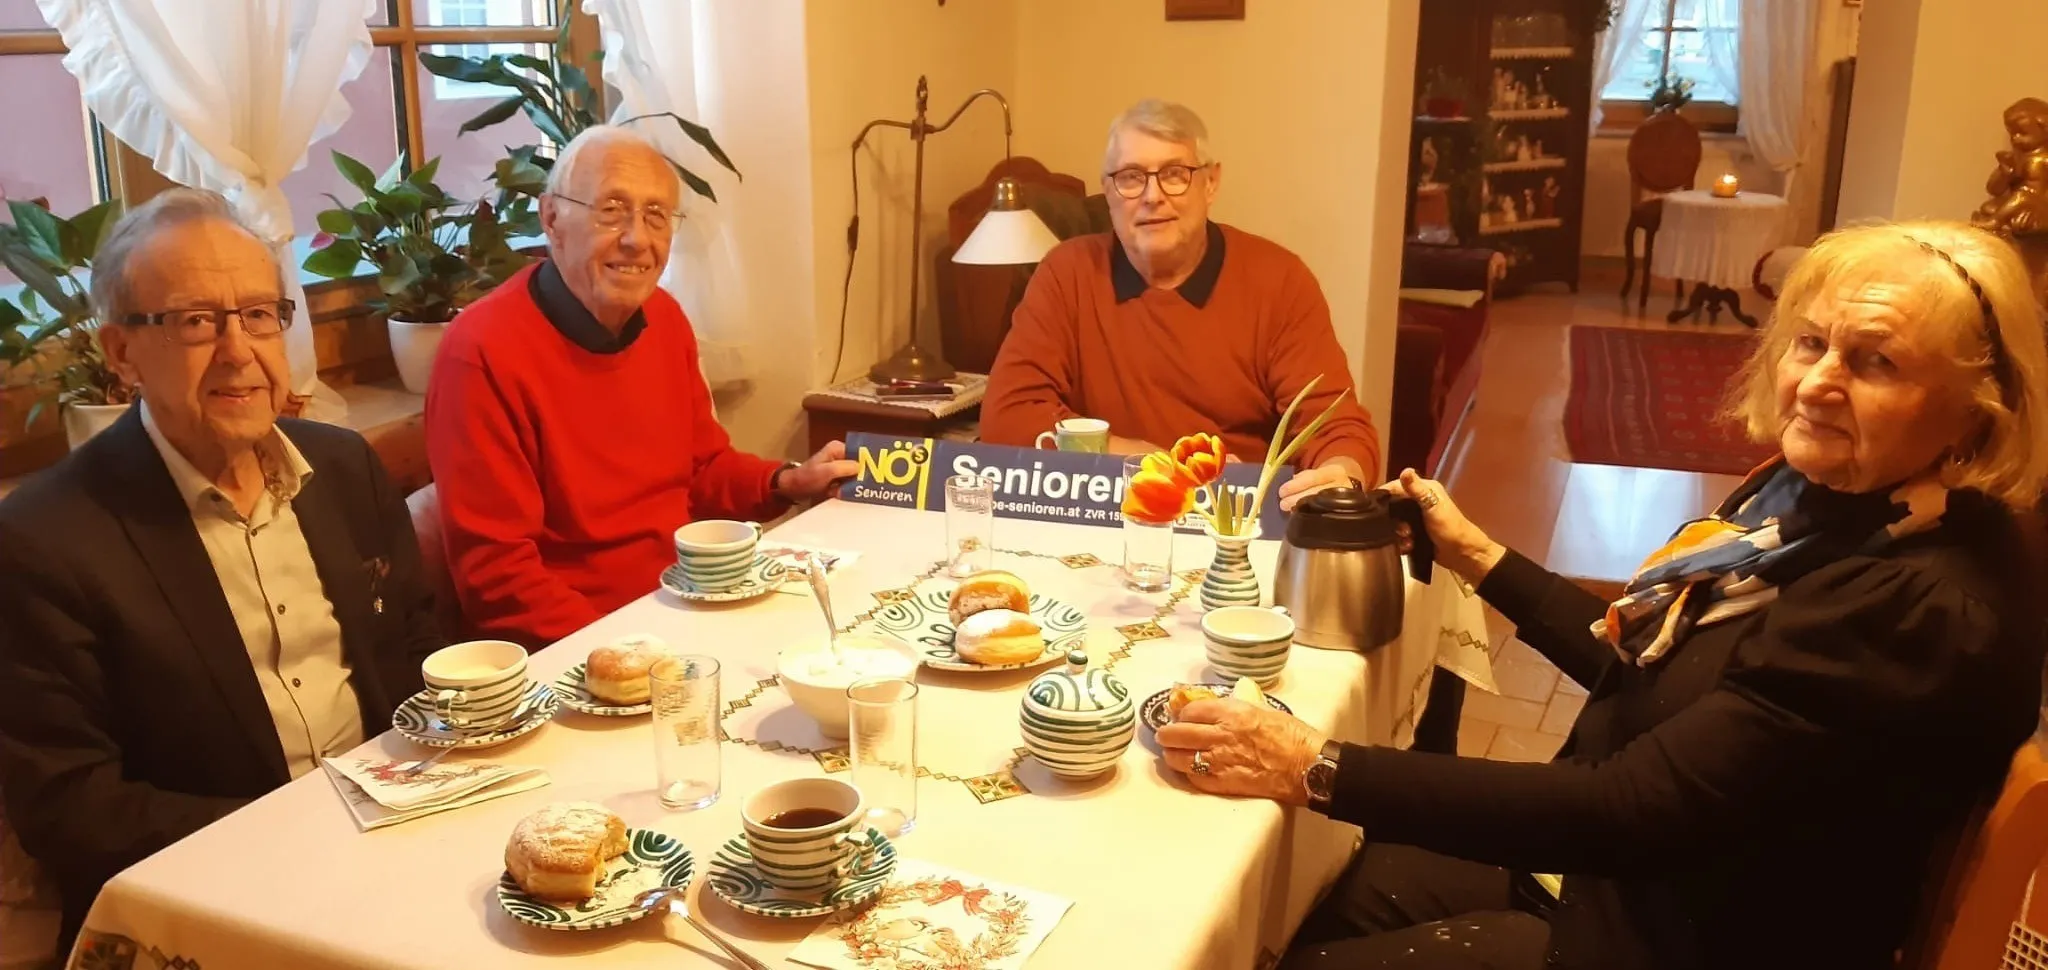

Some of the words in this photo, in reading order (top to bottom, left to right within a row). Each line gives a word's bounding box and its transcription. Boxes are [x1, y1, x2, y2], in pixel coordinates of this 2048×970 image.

[854, 485, 913, 502] Senioren
[1192, 483, 1260, 515] orn
[1084, 509, 1106, 520] ZVR
[1108, 511, 1124, 521] 15
